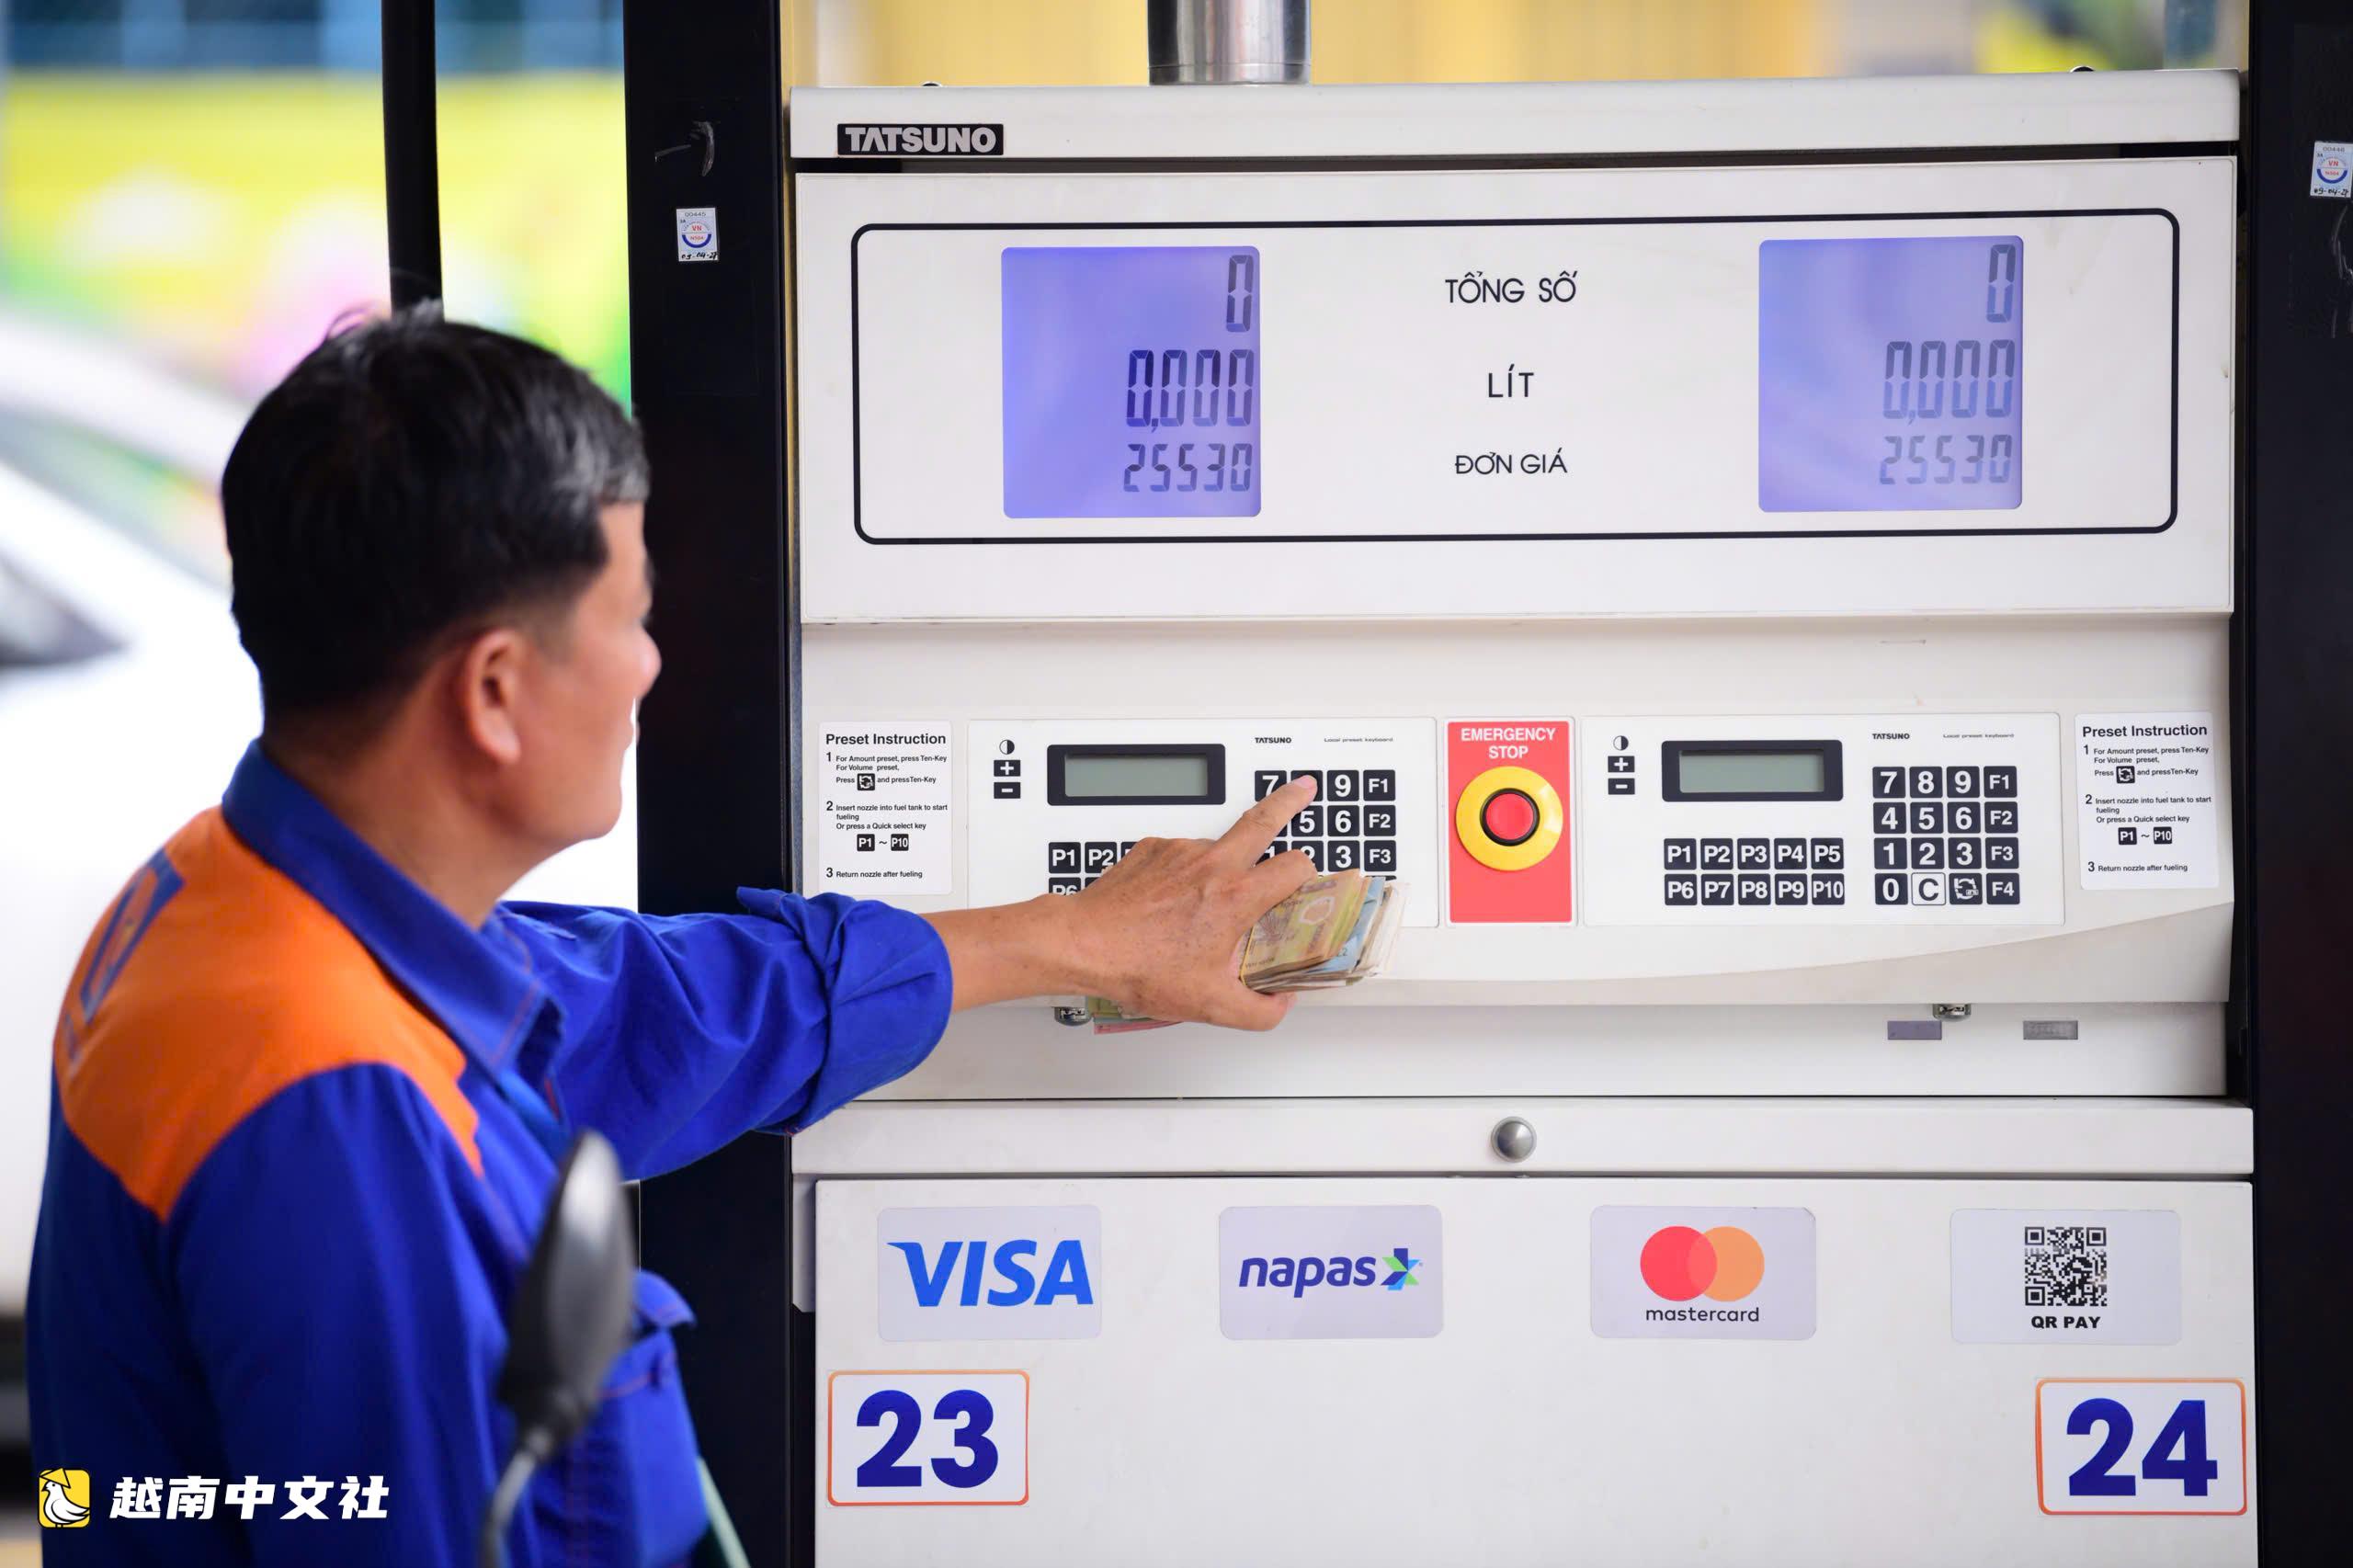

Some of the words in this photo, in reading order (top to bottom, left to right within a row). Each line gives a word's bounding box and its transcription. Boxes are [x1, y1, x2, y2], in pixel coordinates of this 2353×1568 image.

[845, 126, 996, 153] TATSUNO
[1225, 255, 1253, 332] 0
[1445, 271, 1525, 303] TỔNG
[1539, 270, 1577, 302] SỐ
[1986, 244, 2016, 323] 0
[1126, 349, 1254, 432] 0,000
[1488, 364, 1534, 397] LÍT
[1883, 339, 2016, 426] 0,000
[1123, 443, 1252, 492] 25530
[1455, 452, 1512, 474] ĐƠN
[1520, 448, 1567, 473] GIÁ
[1879, 435, 2013, 485] 25530
[825, 733, 869, 744] Preset
[873, 733, 946, 744] Instruction
[1461, 728, 1555, 741] EMERGENCY
[2083, 725, 2127, 737] Preset
[2131, 724, 2208, 736] Instruction
[826, 752, 831, 762] 1
[1489, 745, 1529, 758] STOP
[2084, 744, 2089, 755] 1
[2161, 747, 2180, 756] press
[2181, 746, 2209, 755] Ten-Key
[1335, 774, 1351, 797] 9
[1369, 778, 1388, 793] F1
[1881, 771, 1897, 793] 7
[1917, 771, 1934, 794] 8
[1954, 770, 1972, 794] 9
[1989, 775, 2009, 790] F1
[826, 801, 833, 811] 2
[2085, 794, 2092, 804] 2
[836, 813, 859, 822] fueling
[1881, 807, 1898, 830] 4
[1918, 807, 1935, 830] 5
[1955, 807, 1972, 830] 6
[1990, 811, 2013, 825] F2
[2097, 807, 2120, 815] fueling
[2177, 815, 2189, 824] key
[915, 823, 926, 831] key
[1299, 811, 1315, 834] 5
[1335, 811, 1351, 834] 6
[1369, 814, 1391, 828] F2
[858, 838, 872, 847] P1
[892, 838, 908, 847] P10
[2120, 832, 2134, 841] P1
[2154, 831, 2172, 841] P10
[1052, 849, 1075, 866] P1
[1088, 849, 1114, 866] P2
[1336, 846, 1351, 869] 3
[1370, 849, 1391, 864] F3
[1667, 846, 1690, 863] P1
[1704, 846, 1731, 863] P2
[1741, 846, 1768, 863] P3
[1778, 846, 1804, 863] P4
[1814, 846, 1840, 863] P5
[1883, 843, 1894, 865] 1
[1919, 843, 1936, 865] 2
[1956, 843, 1973, 865] 3
[1991, 846, 2014, 861] F3
[826, 868, 833, 878] 3
[900, 870, 923, 879] fueling
[2087, 862, 2095, 872] 3
[2164, 864, 2188, 872] fueling
[1668, 881, 1694, 899] P6
[1705, 881, 1731, 899] P7
[1742, 881, 1768, 899] P8
[1779, 881, 1804, 899] P9
[1813, 881, 1844, 899] P10
[1882, 879, 1899, 902] 0
[1918, 878, 1938, 901] C
[1992, 882, 2015, 896] F4
[886, 1239, 1094, 1308] VISA
[1238, 1255, 1377, 1299] napas
[1645, 1305, 1760, 1324] mastercard
[2030, 1316, 2058, 1330] QR
[2063, 1316, 2101, 1329] PAY
[856, 1389, 999, 1489] 23
[2065, 1397, 2218, 1496] 24
